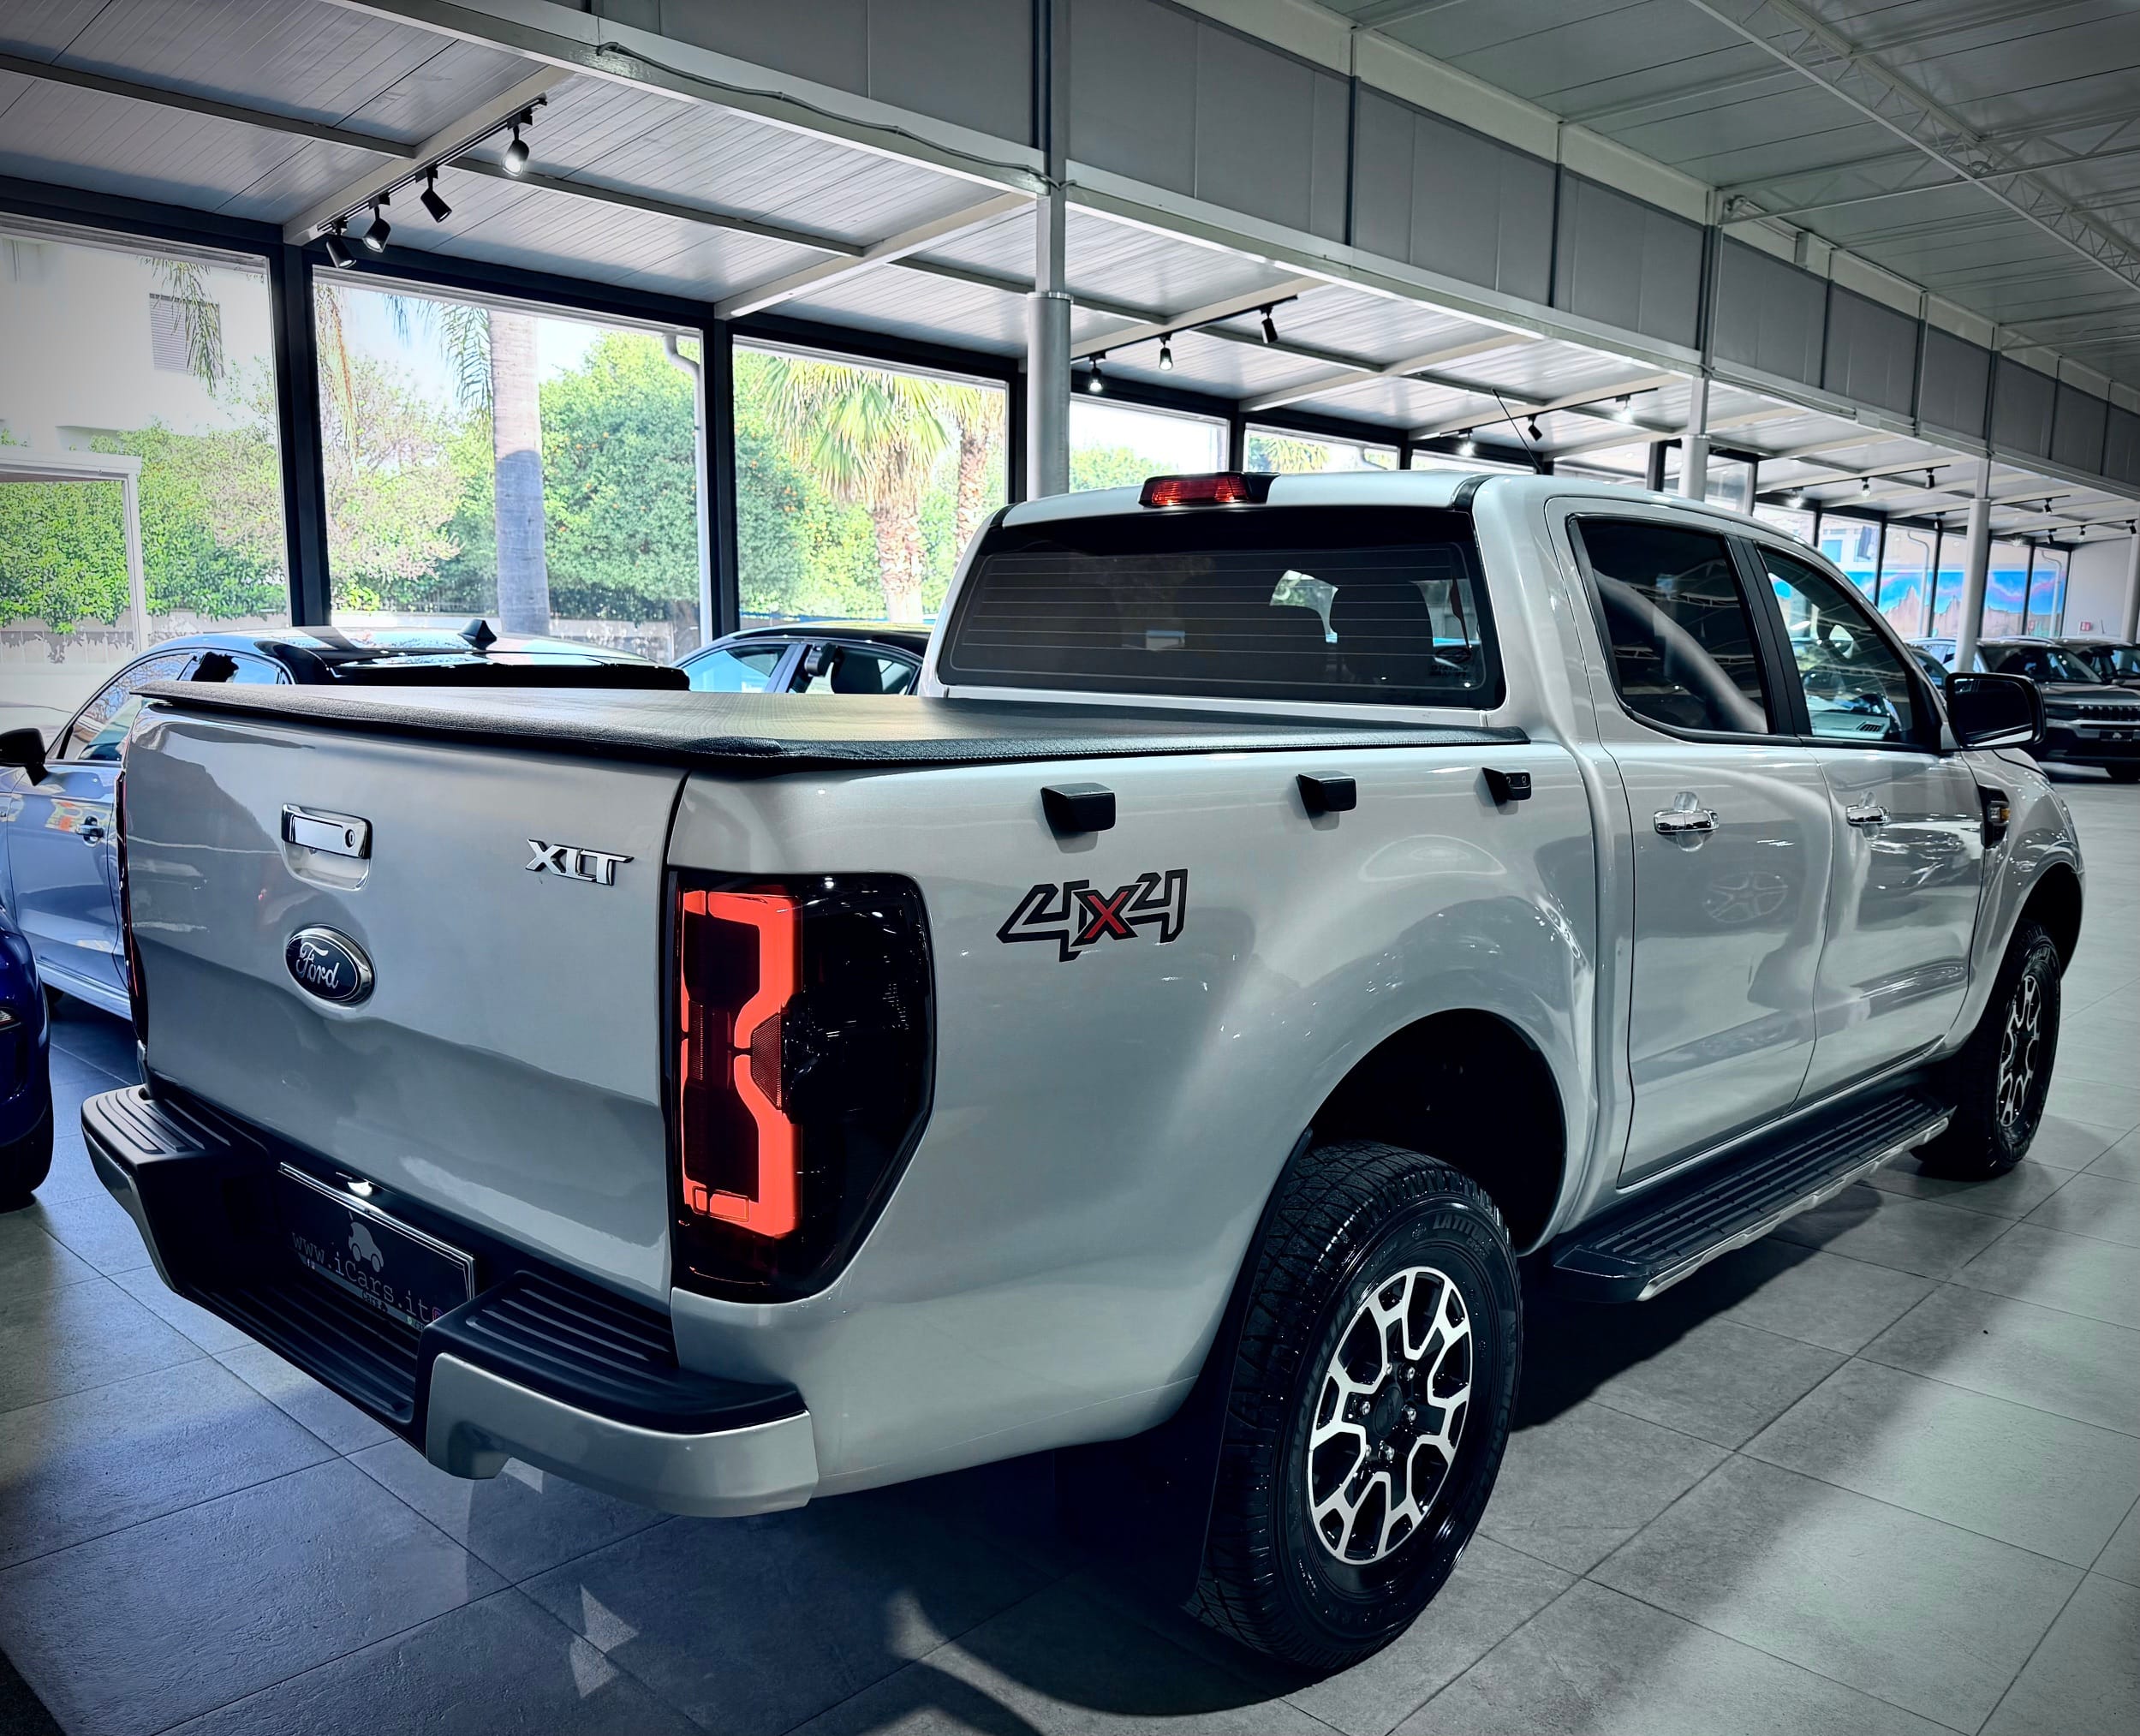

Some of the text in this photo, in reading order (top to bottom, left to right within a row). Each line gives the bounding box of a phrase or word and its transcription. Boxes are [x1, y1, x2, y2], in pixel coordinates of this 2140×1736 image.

[526, 838, 635, 886] XLT
[296, 942, 340, 989] Ford
[291, 1232, 430, 1323] www.iCars.it
